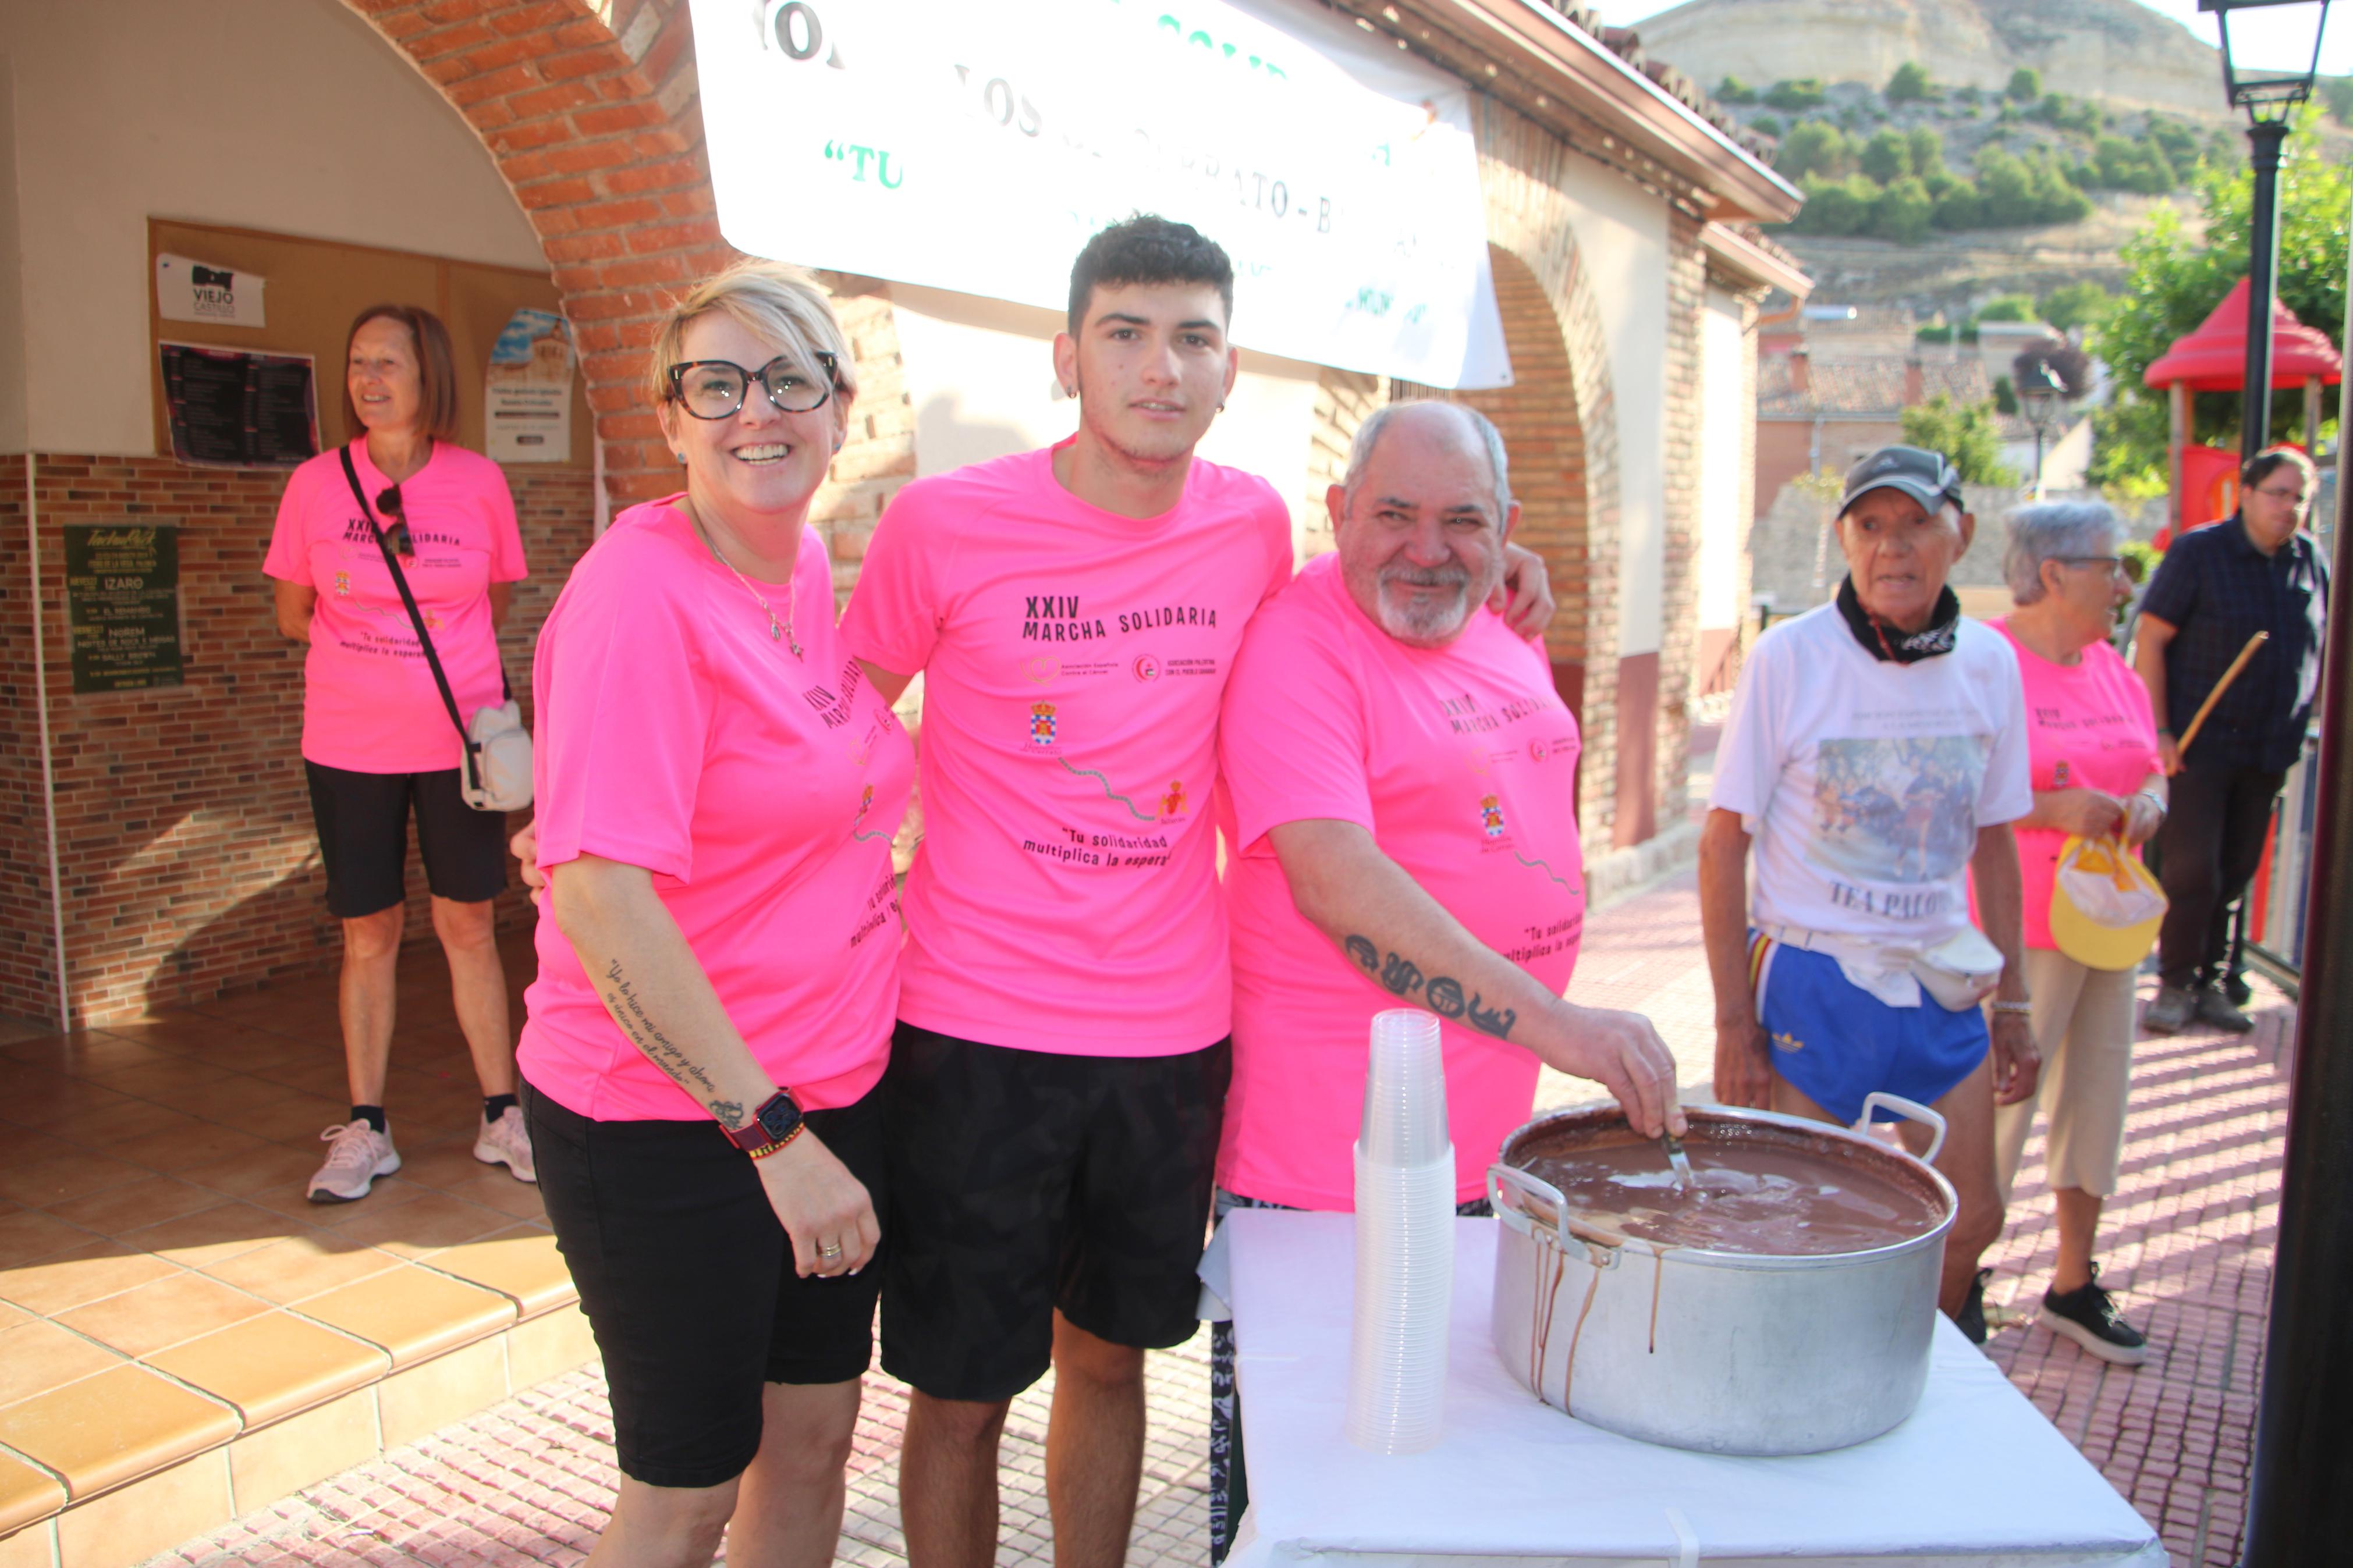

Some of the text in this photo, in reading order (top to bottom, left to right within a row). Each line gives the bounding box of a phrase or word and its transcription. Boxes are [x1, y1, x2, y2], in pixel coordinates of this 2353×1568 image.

[194, 289, 233, 304] VIEJO
[343, 531, 460, 546] MARC LIDARIA
[104, 576, 143, 590] IZARO
[1026, 596, 1078, 619] XXIV
[1023, 607, 1216, 642] MARCHA SOLIDARIA
[1023, 840, 1099, 865] multiplica
[1107, 853, 1119, 866] la
[1092, 835, 1167, 848] solidaridad
[619, 982, 630, 996] lo
[627, 993, 643, 1018] hice
[641, 1016, 655, 1033] mi
[653, 1030, 683, 1059] amigo
[677, 1056, 691, 1068] y
[689, 1064, 716, 1093] ahora
[631, 1030, 643, 1044] en
[643, 1043, 658, 1055] el
